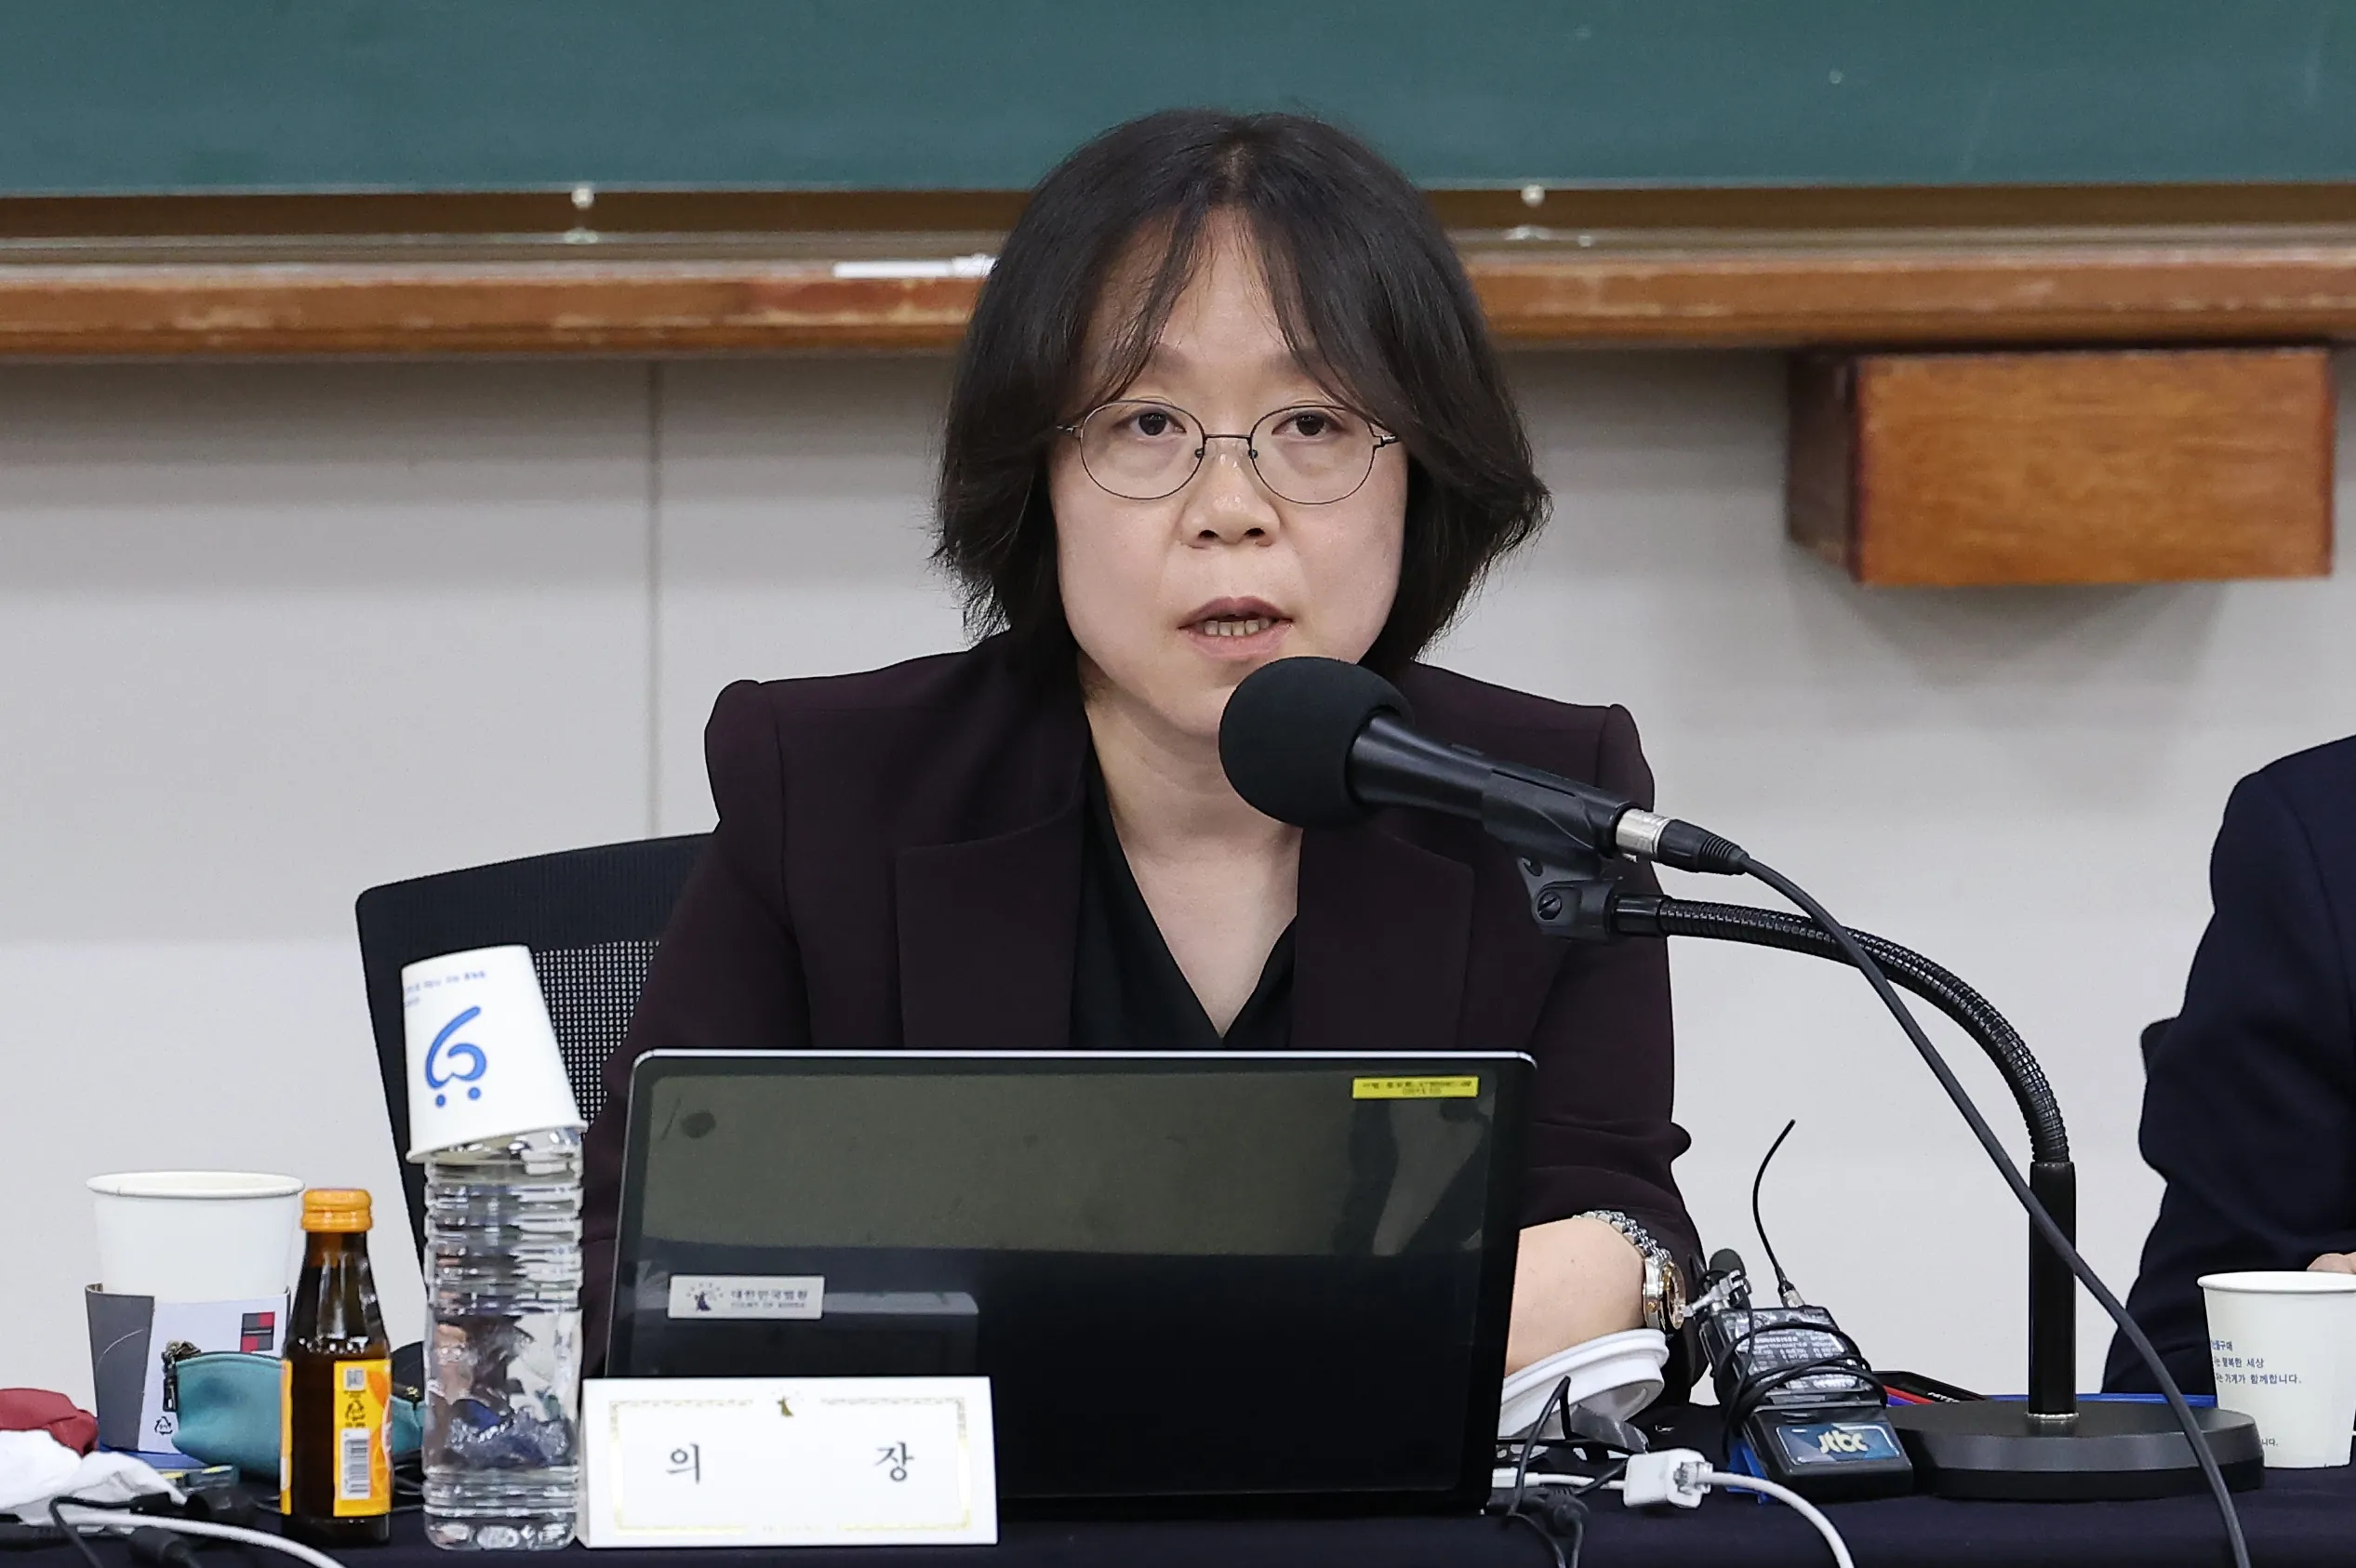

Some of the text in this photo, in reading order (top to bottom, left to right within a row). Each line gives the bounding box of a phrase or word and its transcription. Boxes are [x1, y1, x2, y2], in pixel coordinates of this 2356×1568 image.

[2247, 1358, 2264, 1368] 세상
[2251, 1374, 2302, 1384] 함께합니다.
[2261, 1438, 2278, 1446] 니다.
[665, 1441, 915, 1485] 의 장
